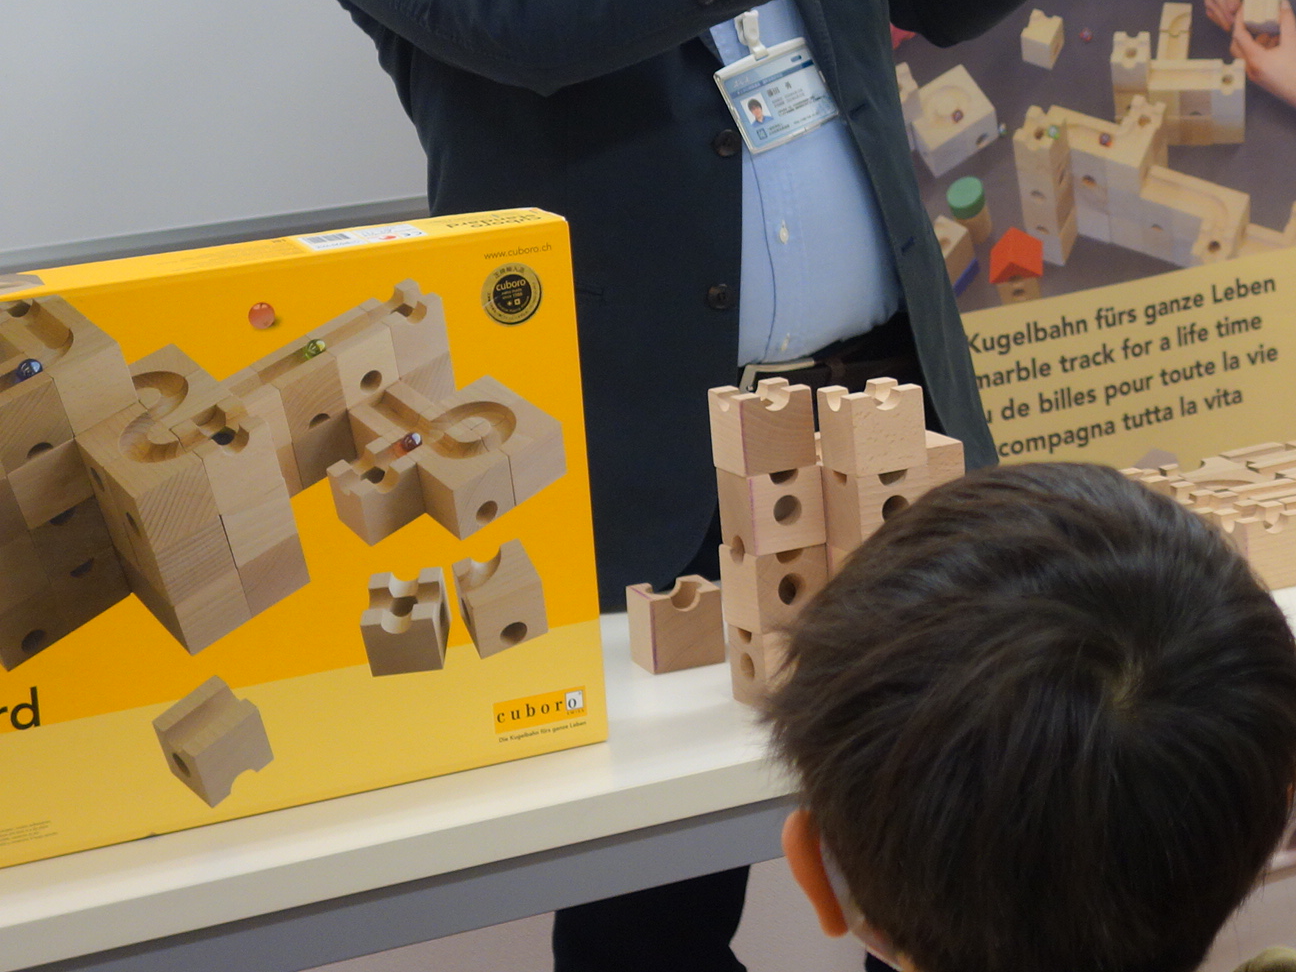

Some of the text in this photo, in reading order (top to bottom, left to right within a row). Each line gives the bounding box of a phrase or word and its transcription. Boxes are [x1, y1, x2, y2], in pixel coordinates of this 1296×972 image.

[484, 242, 552, 260] www.cuboro.ch
[495, 278, 527, 292] cuboro
[968, 277, 1276, 355] Kugelbahn fürs ganze Leben
[1059, 343, 1115, 374] track
[1121, 338, 1152, 360] for
[1159, 335, 1171, 351] a
[1176, 324, 1208, 348] life
[1215, 314, 1262, 339] time
[1001, 398, 1030, 421] de
[1038, 386, 1096, 414] billes
[1104, 375, 1153, 406] pour
[1159, 359, 1216, 387] toute
[1222, 351, 1240, 372] la
[1247, 344, 1279, 366] vie
[1122, 405, 1174, 431] tutta
[1179, 396, 1198, 417] la
[1203, 388, 1244, 411] vita
[496, 698, 577, 723] cuboro
